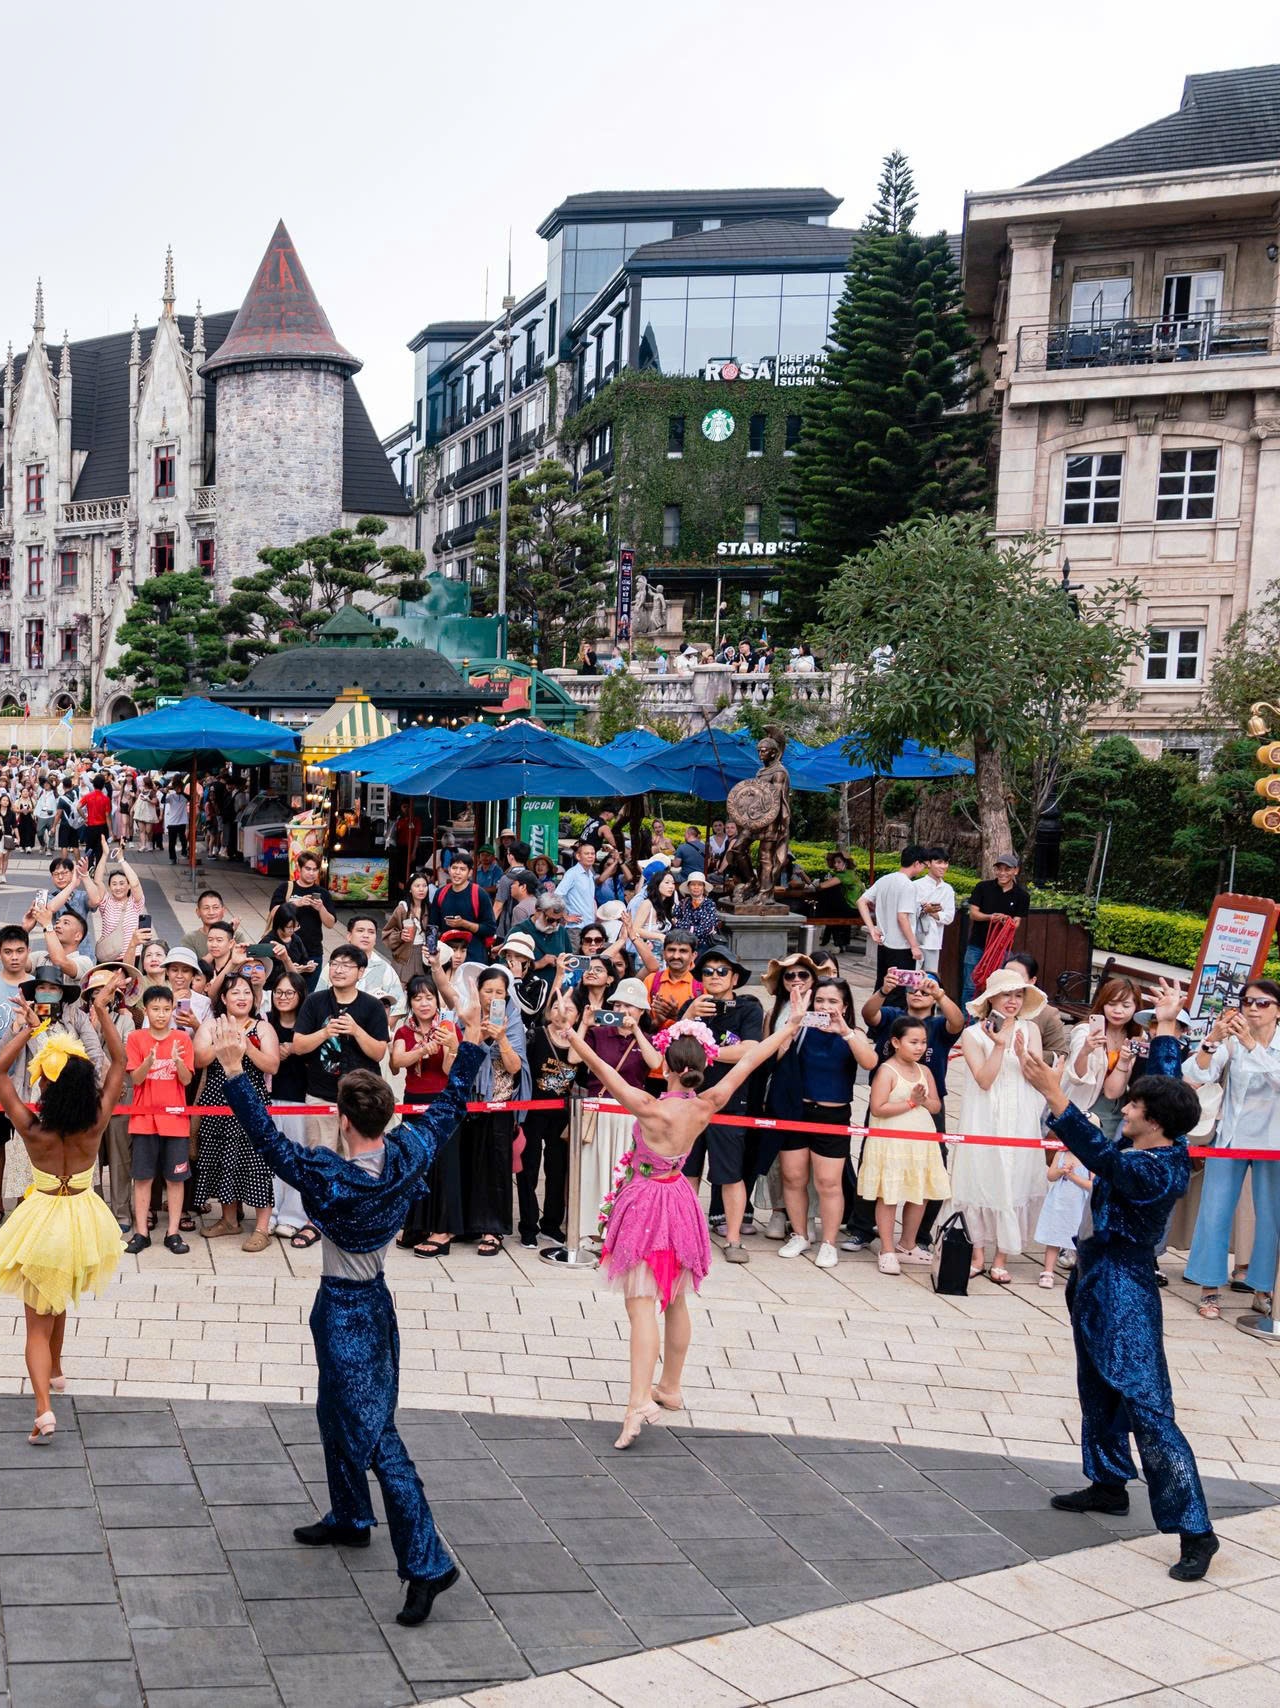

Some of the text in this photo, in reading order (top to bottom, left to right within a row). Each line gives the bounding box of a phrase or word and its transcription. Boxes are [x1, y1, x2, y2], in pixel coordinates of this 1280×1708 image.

[780, 354, 810, 363] DEEP
[705, 363, 771, 381] ROSA
[780, 366, 802, 375] HOT
[780, 377, 815, 386] SUSHI
[717, 542, 818, 555] STARB
